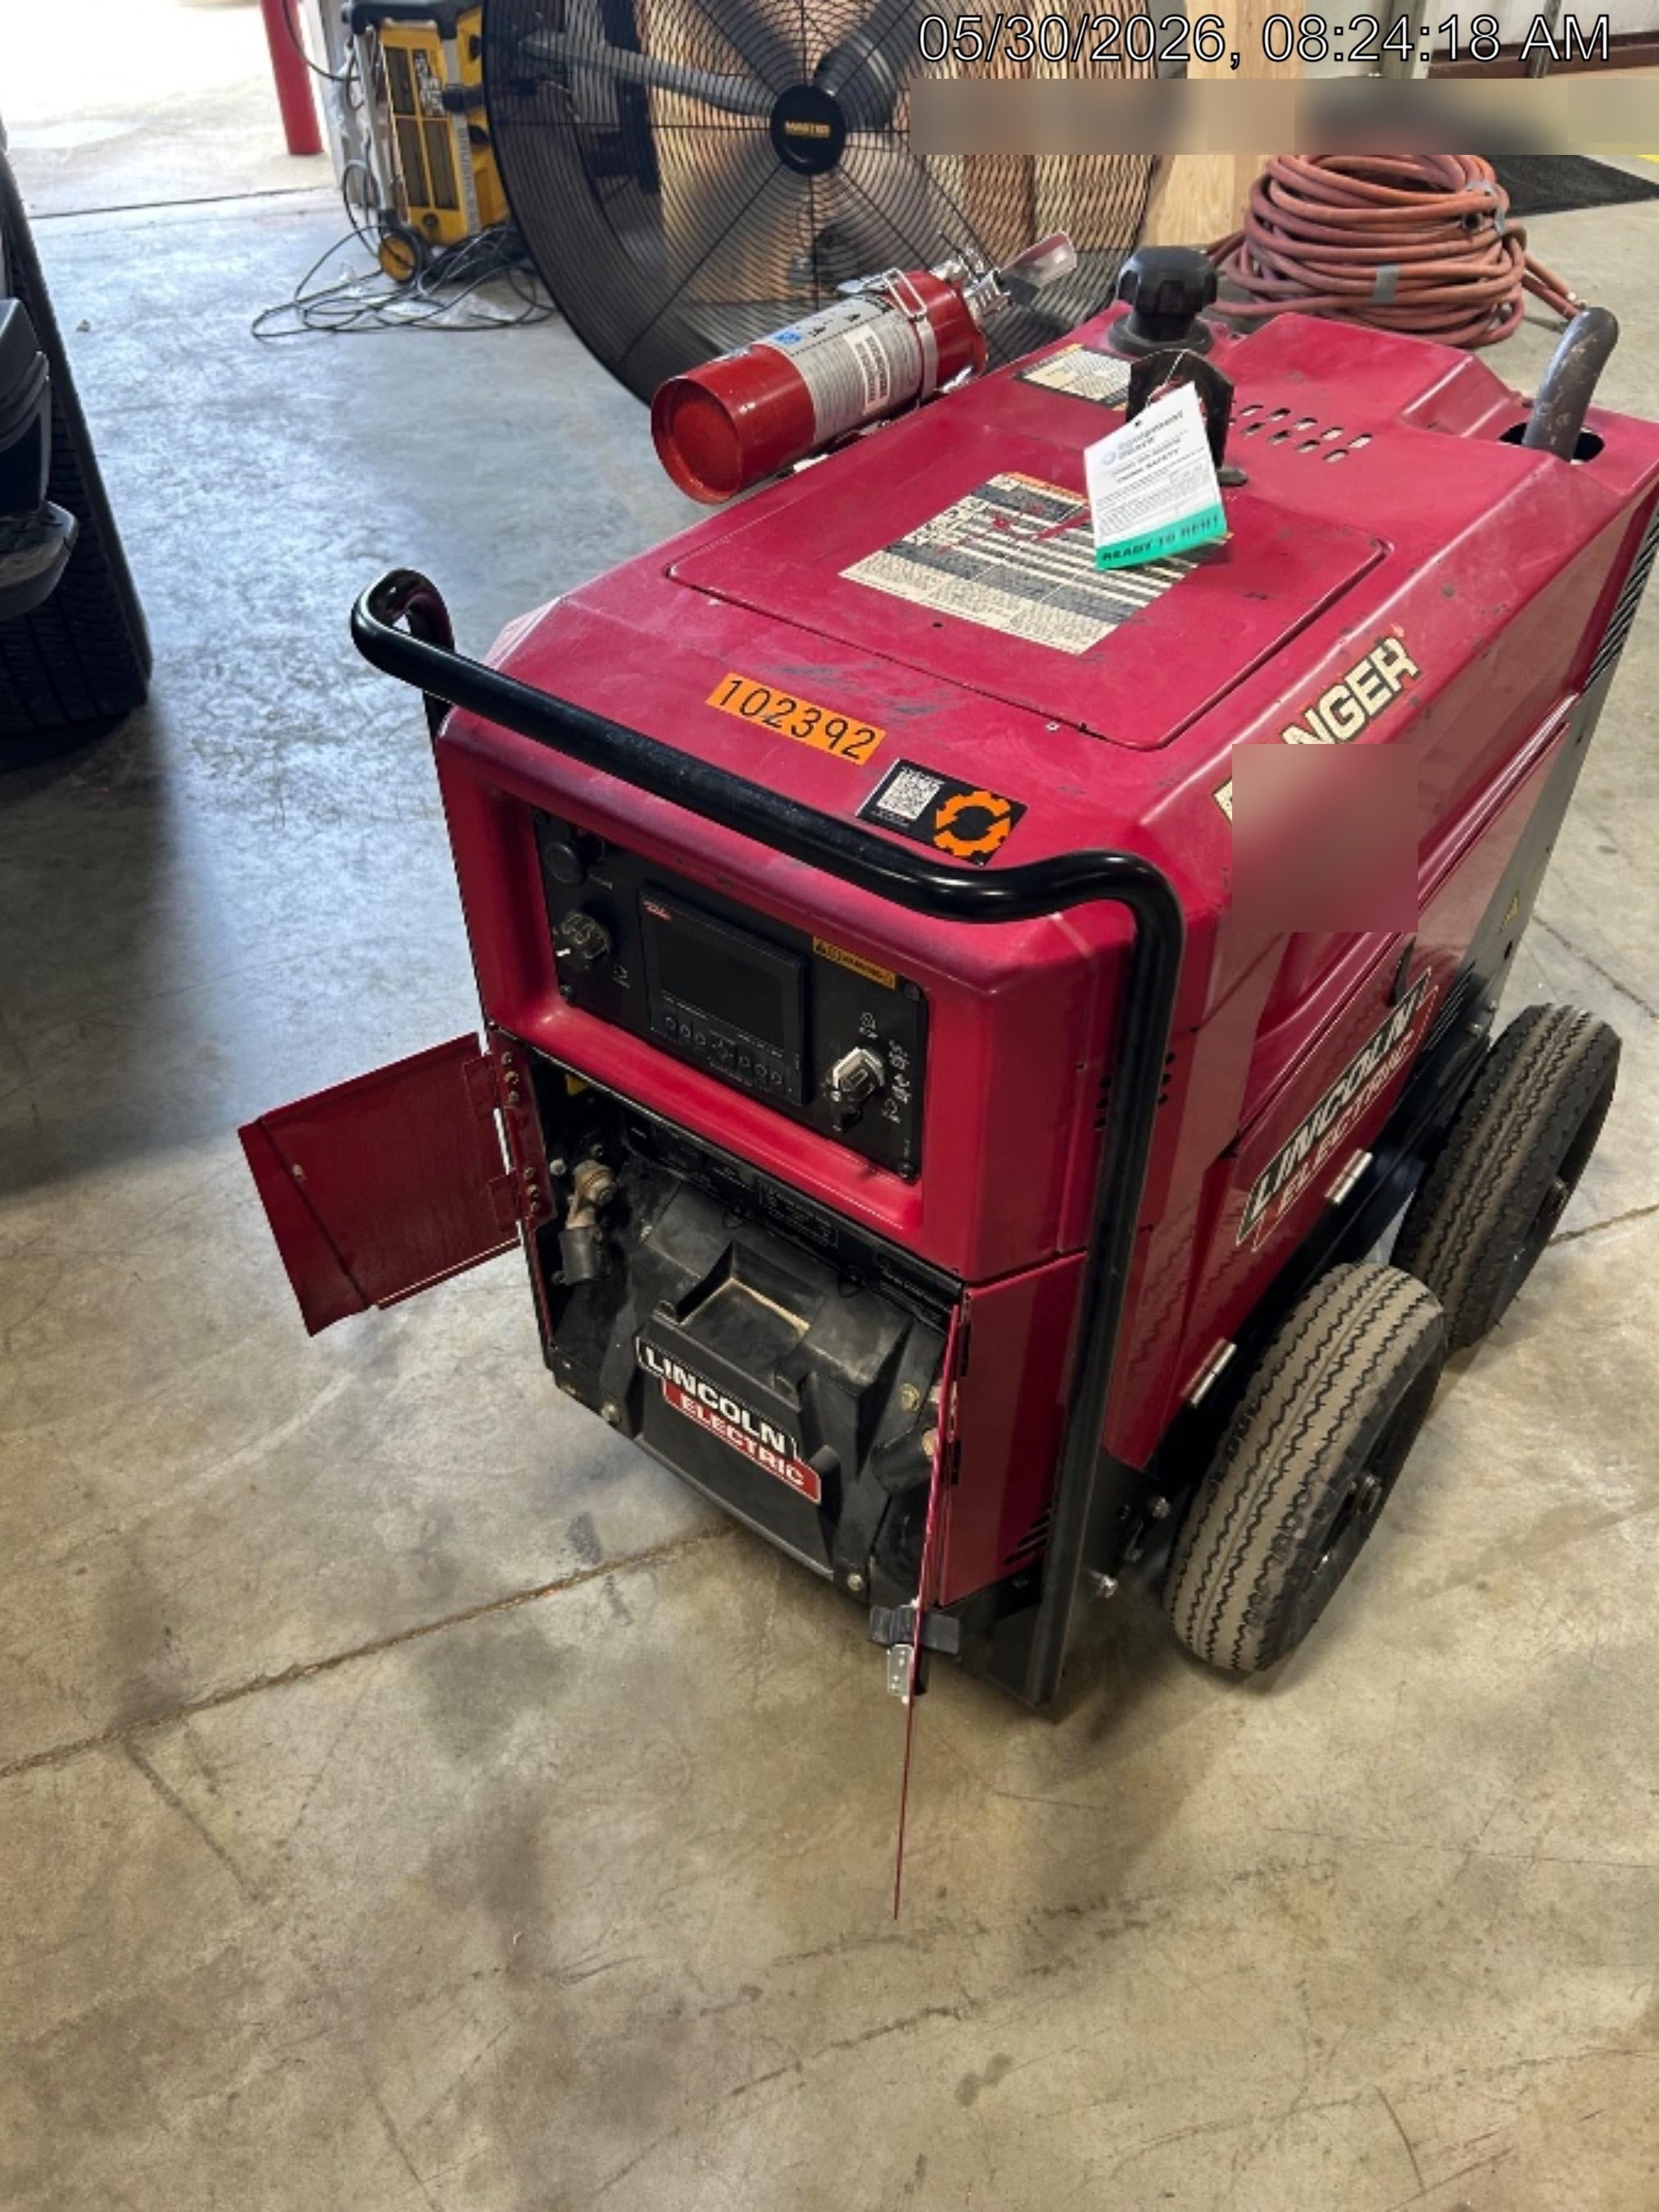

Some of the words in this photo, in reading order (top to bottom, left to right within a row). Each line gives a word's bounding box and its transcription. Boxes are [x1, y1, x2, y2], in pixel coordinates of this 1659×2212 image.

[1102, 539, 1153, 560] READY
[1158, 533, 1176, 546] TO
[718, 679, 877, 760] 102392
[1250, 986, 1424, 1219] LINCOLN
[1277, 1030, 1414, 1216] ELECTRIC
[645, 1345, 786, 1453] LINCOLN
[680, 1393, 805, 1486] ELECTRIC
